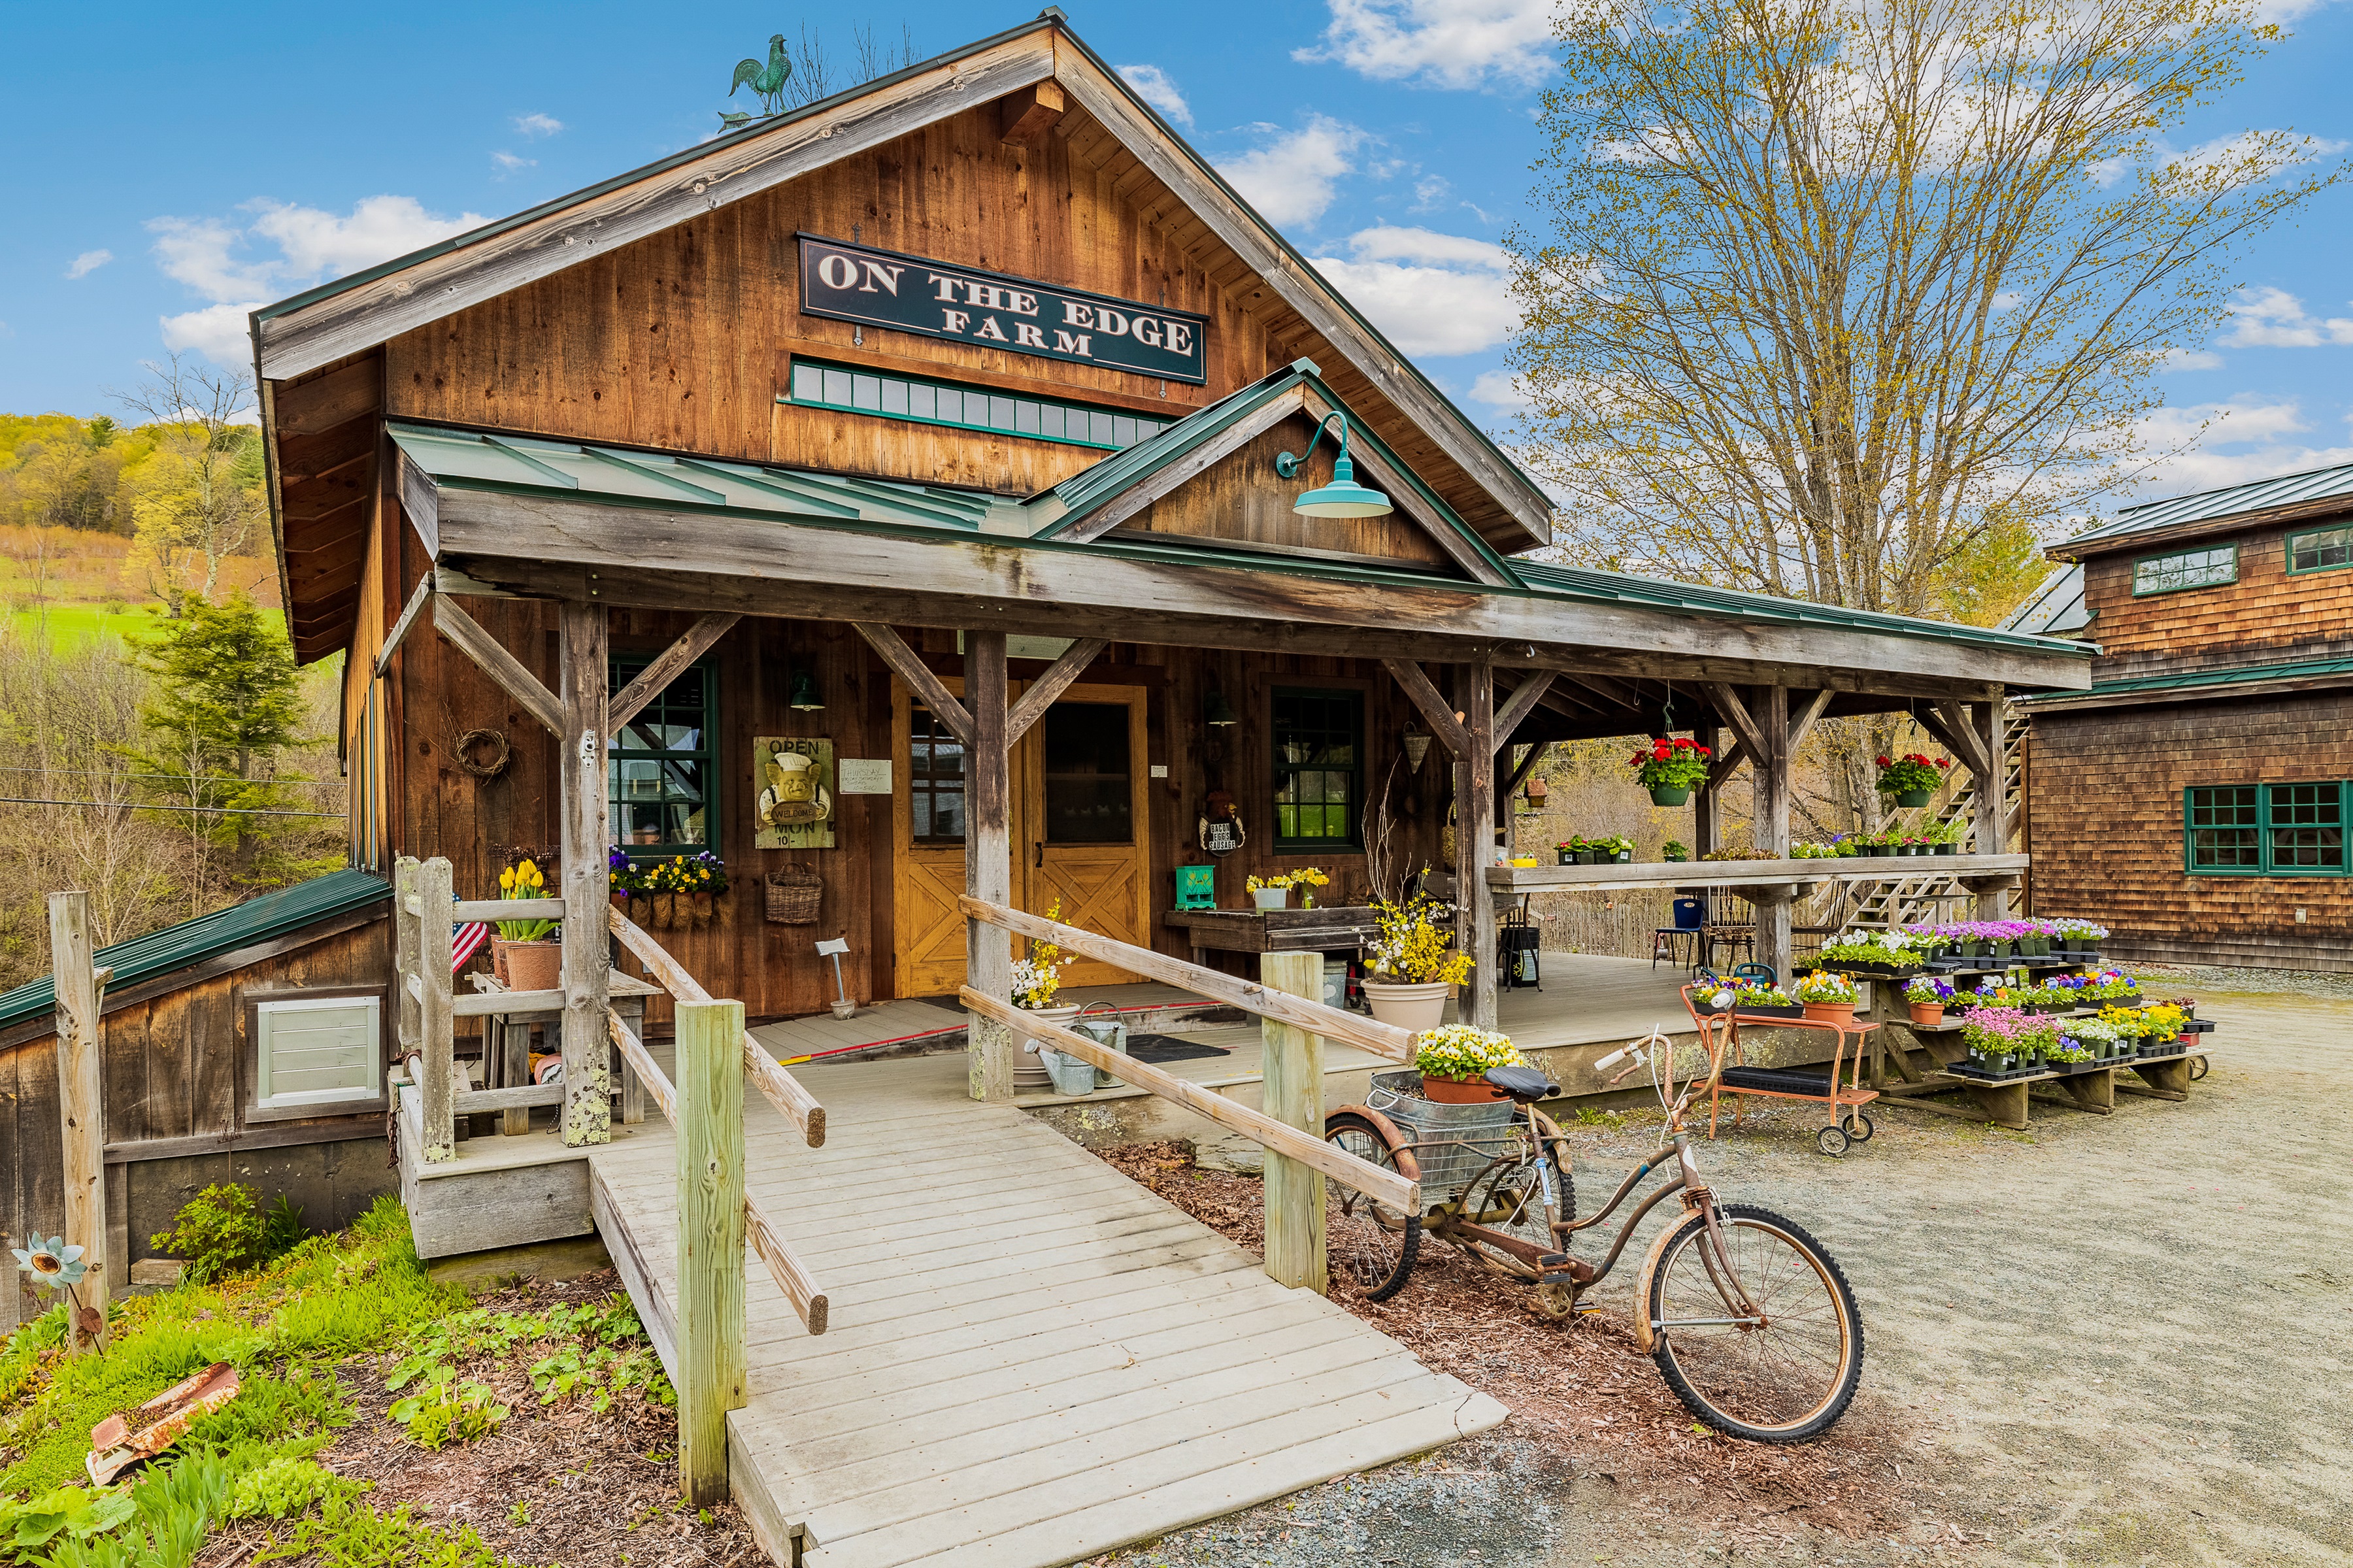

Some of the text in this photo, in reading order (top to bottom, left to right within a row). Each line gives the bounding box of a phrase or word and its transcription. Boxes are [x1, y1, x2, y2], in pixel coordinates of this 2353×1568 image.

[818, 254, 1193, 357] ON THE EDGE
[943, 308, 1093, 358] FARM
[769, 740, 819, 754] OPEN
[775, 809, 813, 818] WELCOME
[775, 822, 815, 835] MON
[1211, 824, 1230, 833] BACON
[1214, 832, 1229, 841] EGGS
[1209, 841, 1235, 849] SAUSAGE
